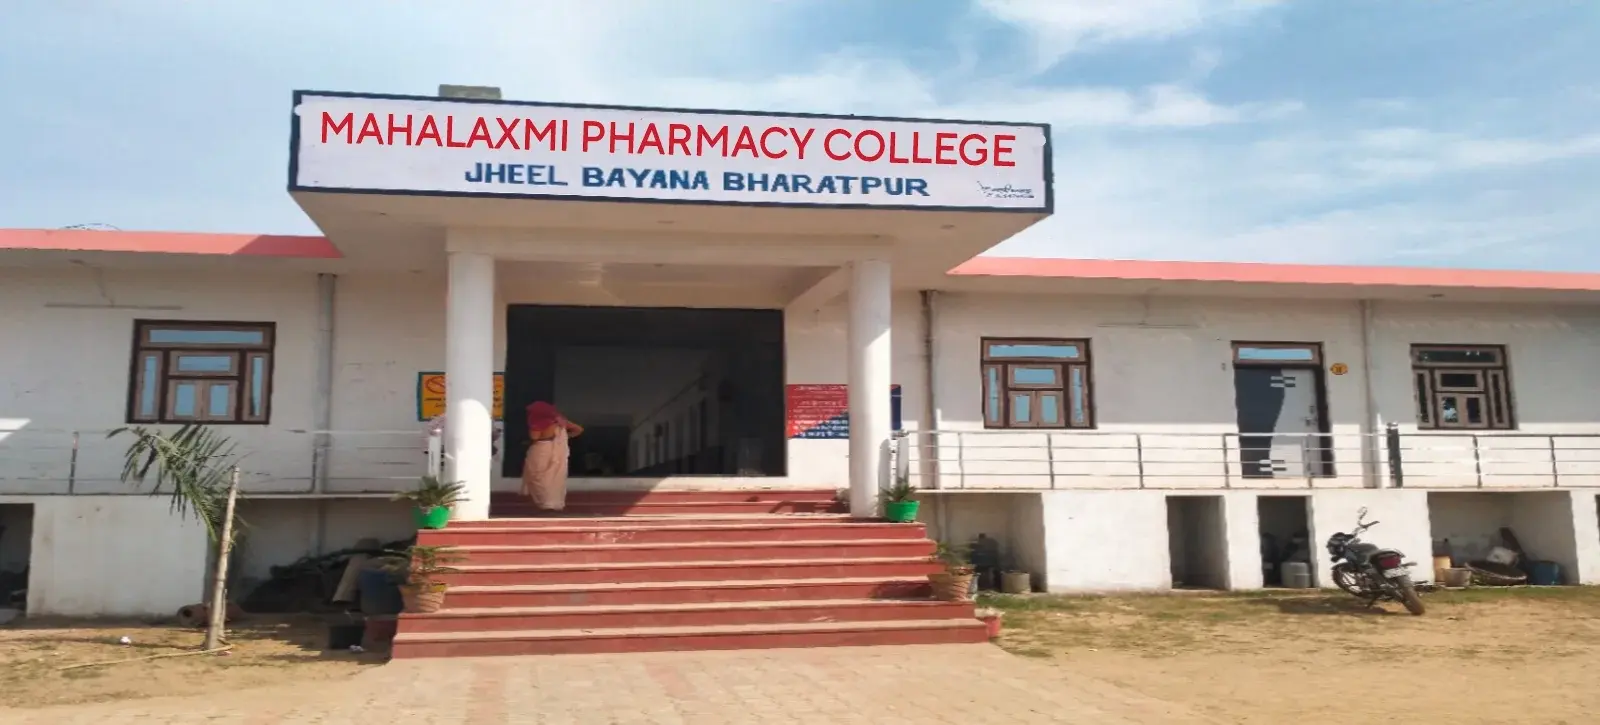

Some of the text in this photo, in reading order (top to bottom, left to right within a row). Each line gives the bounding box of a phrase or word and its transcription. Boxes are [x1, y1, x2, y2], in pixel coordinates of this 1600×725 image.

[321, 111, 1017, 167] MAHALAXMI PHARMACY COLLEGE
[465, 162, 930, 197] JHEEL BAYANA BHARATPUR
